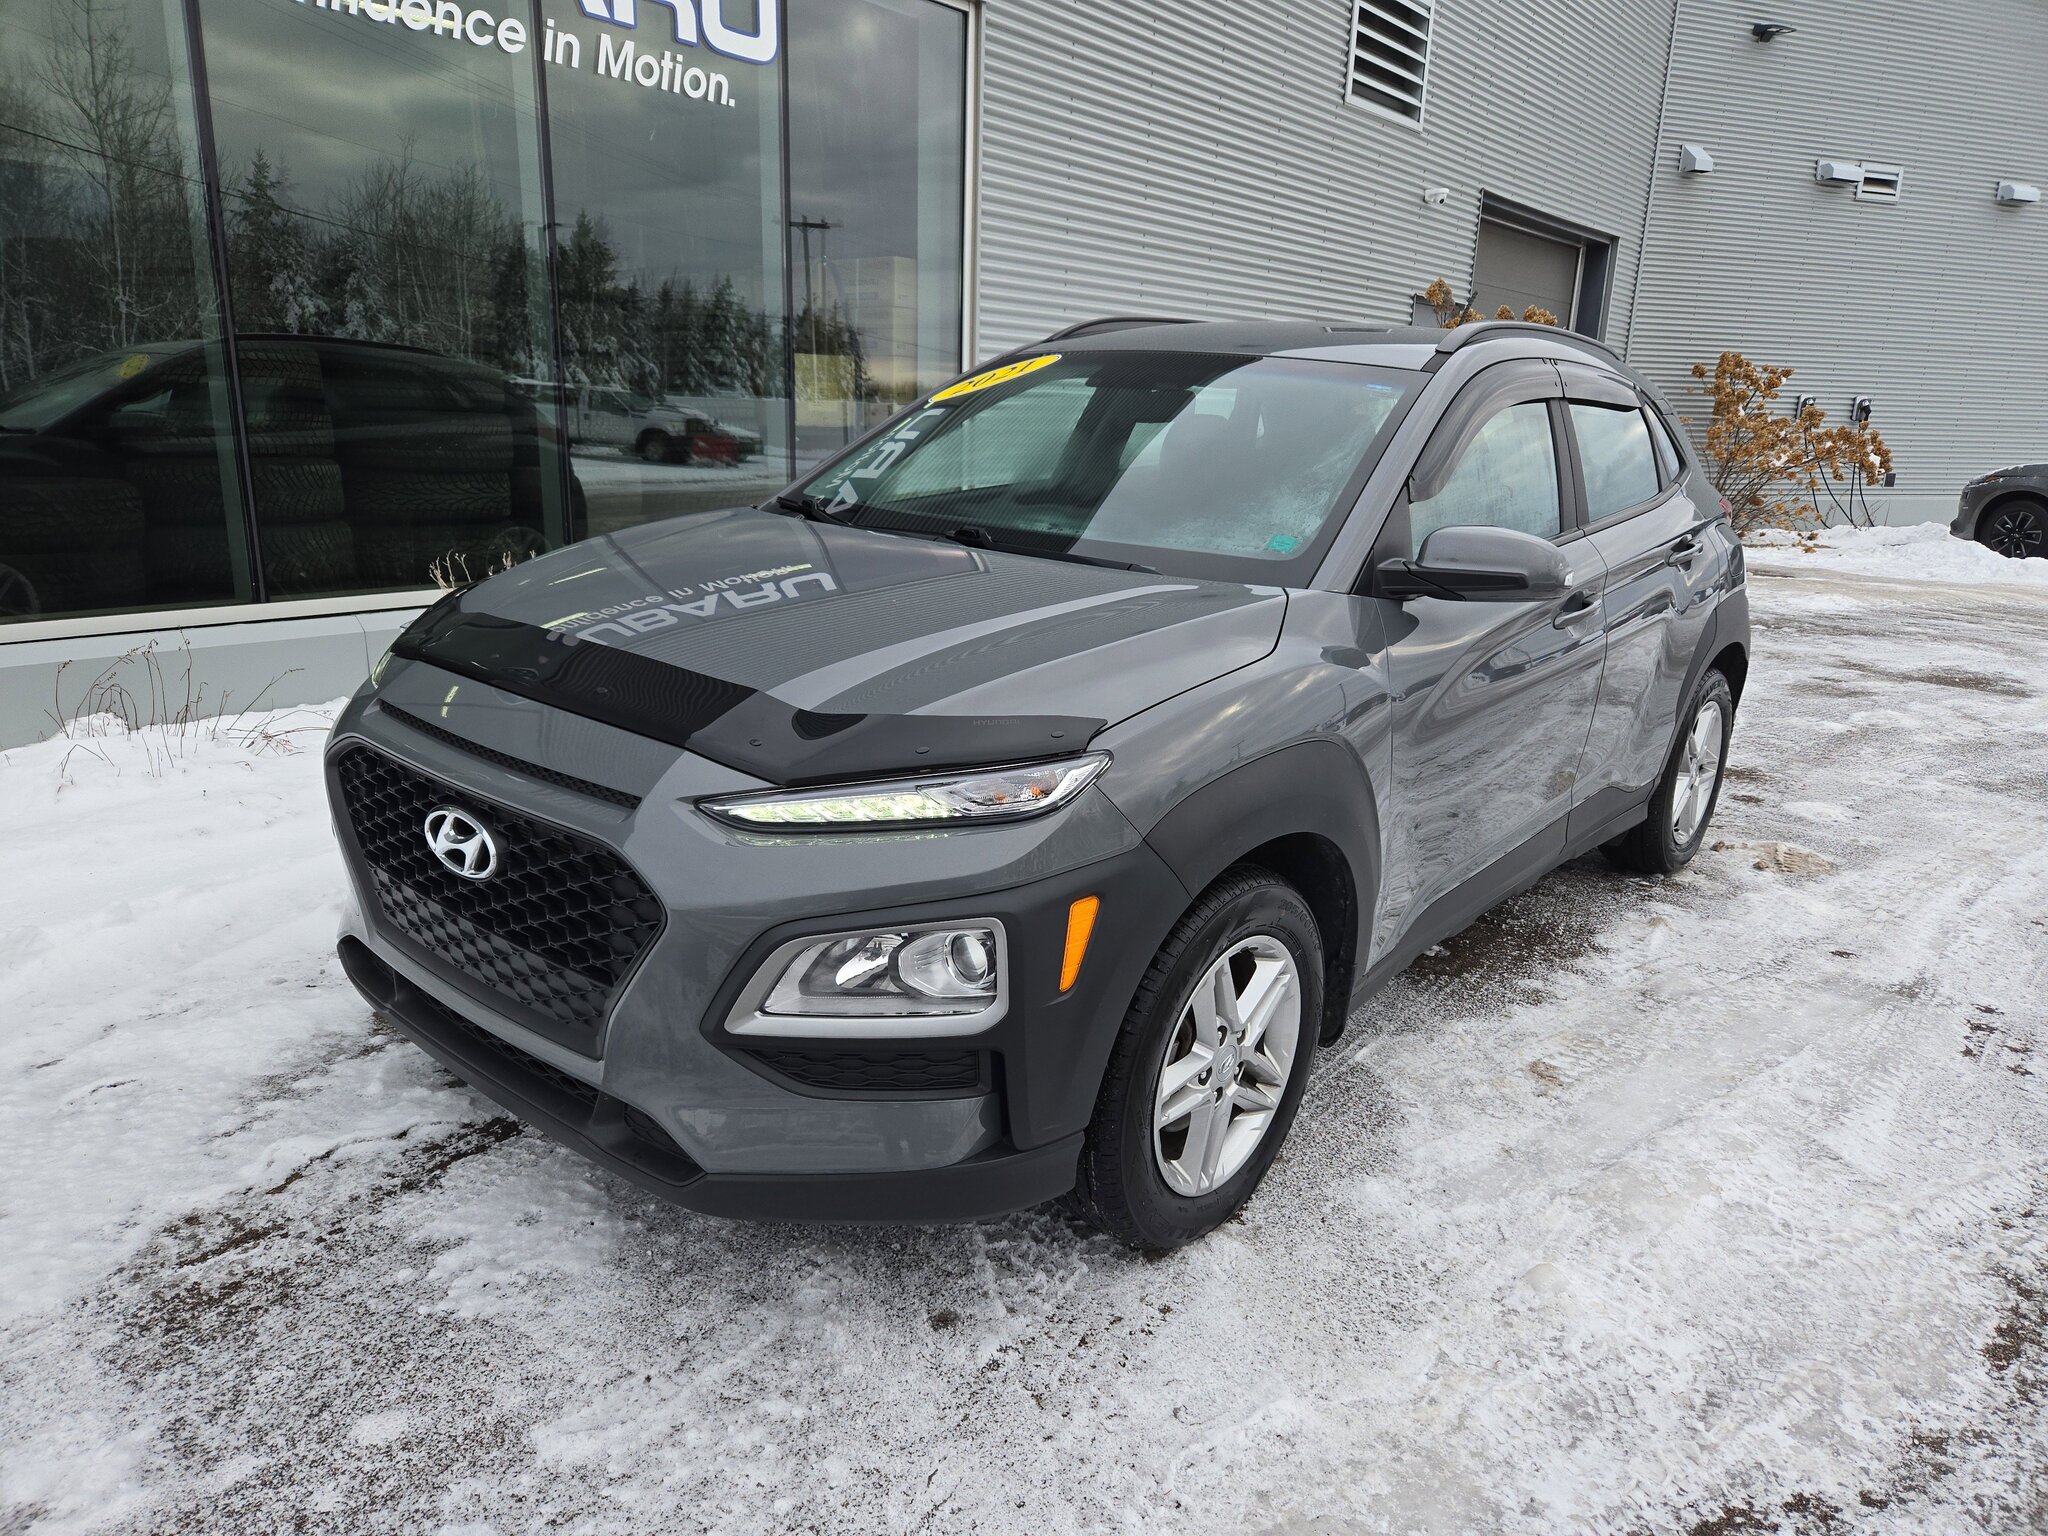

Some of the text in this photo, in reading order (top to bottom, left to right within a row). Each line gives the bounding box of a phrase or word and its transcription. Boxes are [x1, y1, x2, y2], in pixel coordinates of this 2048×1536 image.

[543, 18, 580, 69] in
[597, 32, 736, 108] Motion.
[948, 359, 1037, 396] 2021
[973, 718, 1021, 727] HYUNDAI
